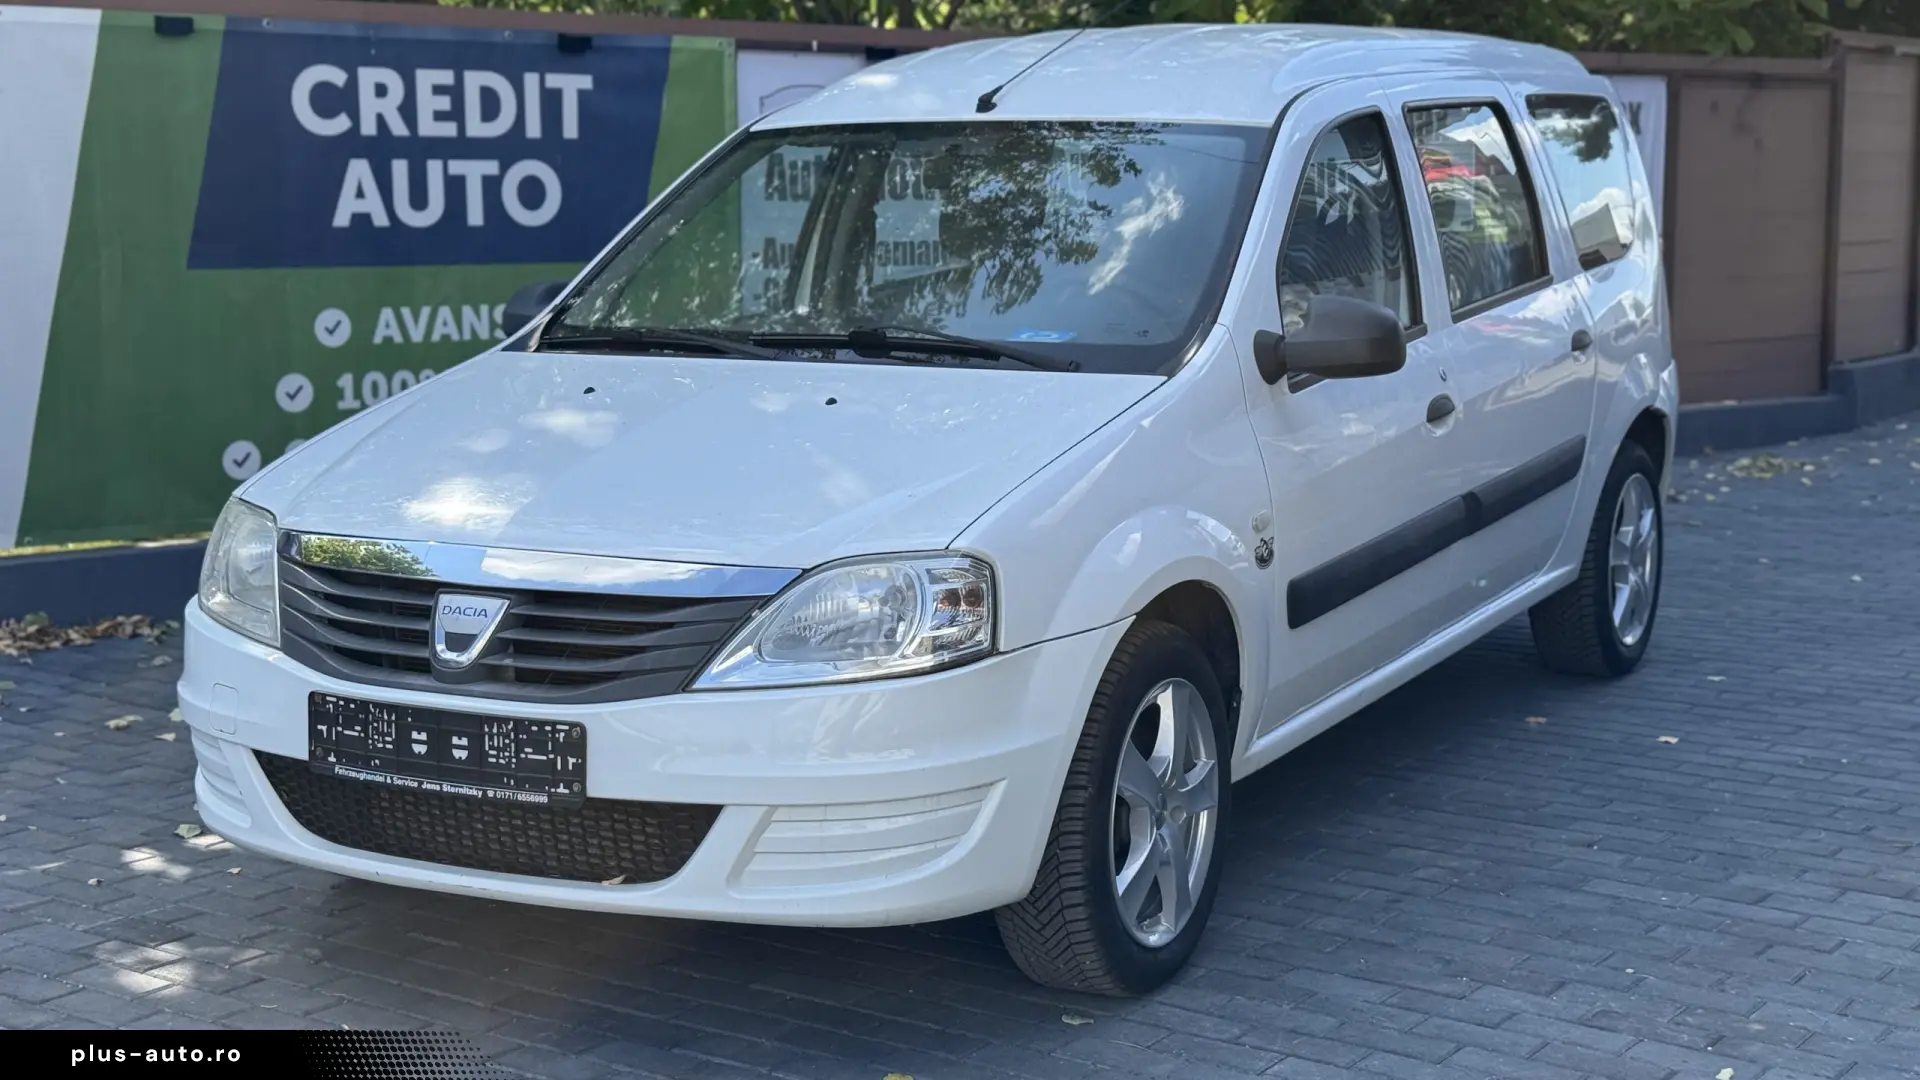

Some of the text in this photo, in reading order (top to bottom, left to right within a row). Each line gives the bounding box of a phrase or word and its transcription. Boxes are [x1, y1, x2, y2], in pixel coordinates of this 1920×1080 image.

[290, 63, 594, 139] CREDIT
[331, 158, 563, 228] AUTO
[442, 605, 488, 618] DACIA
[386, 776, 392, 784] &
[393, 776, 418, 788] Service
[421, 781, 441, 791] Jens
